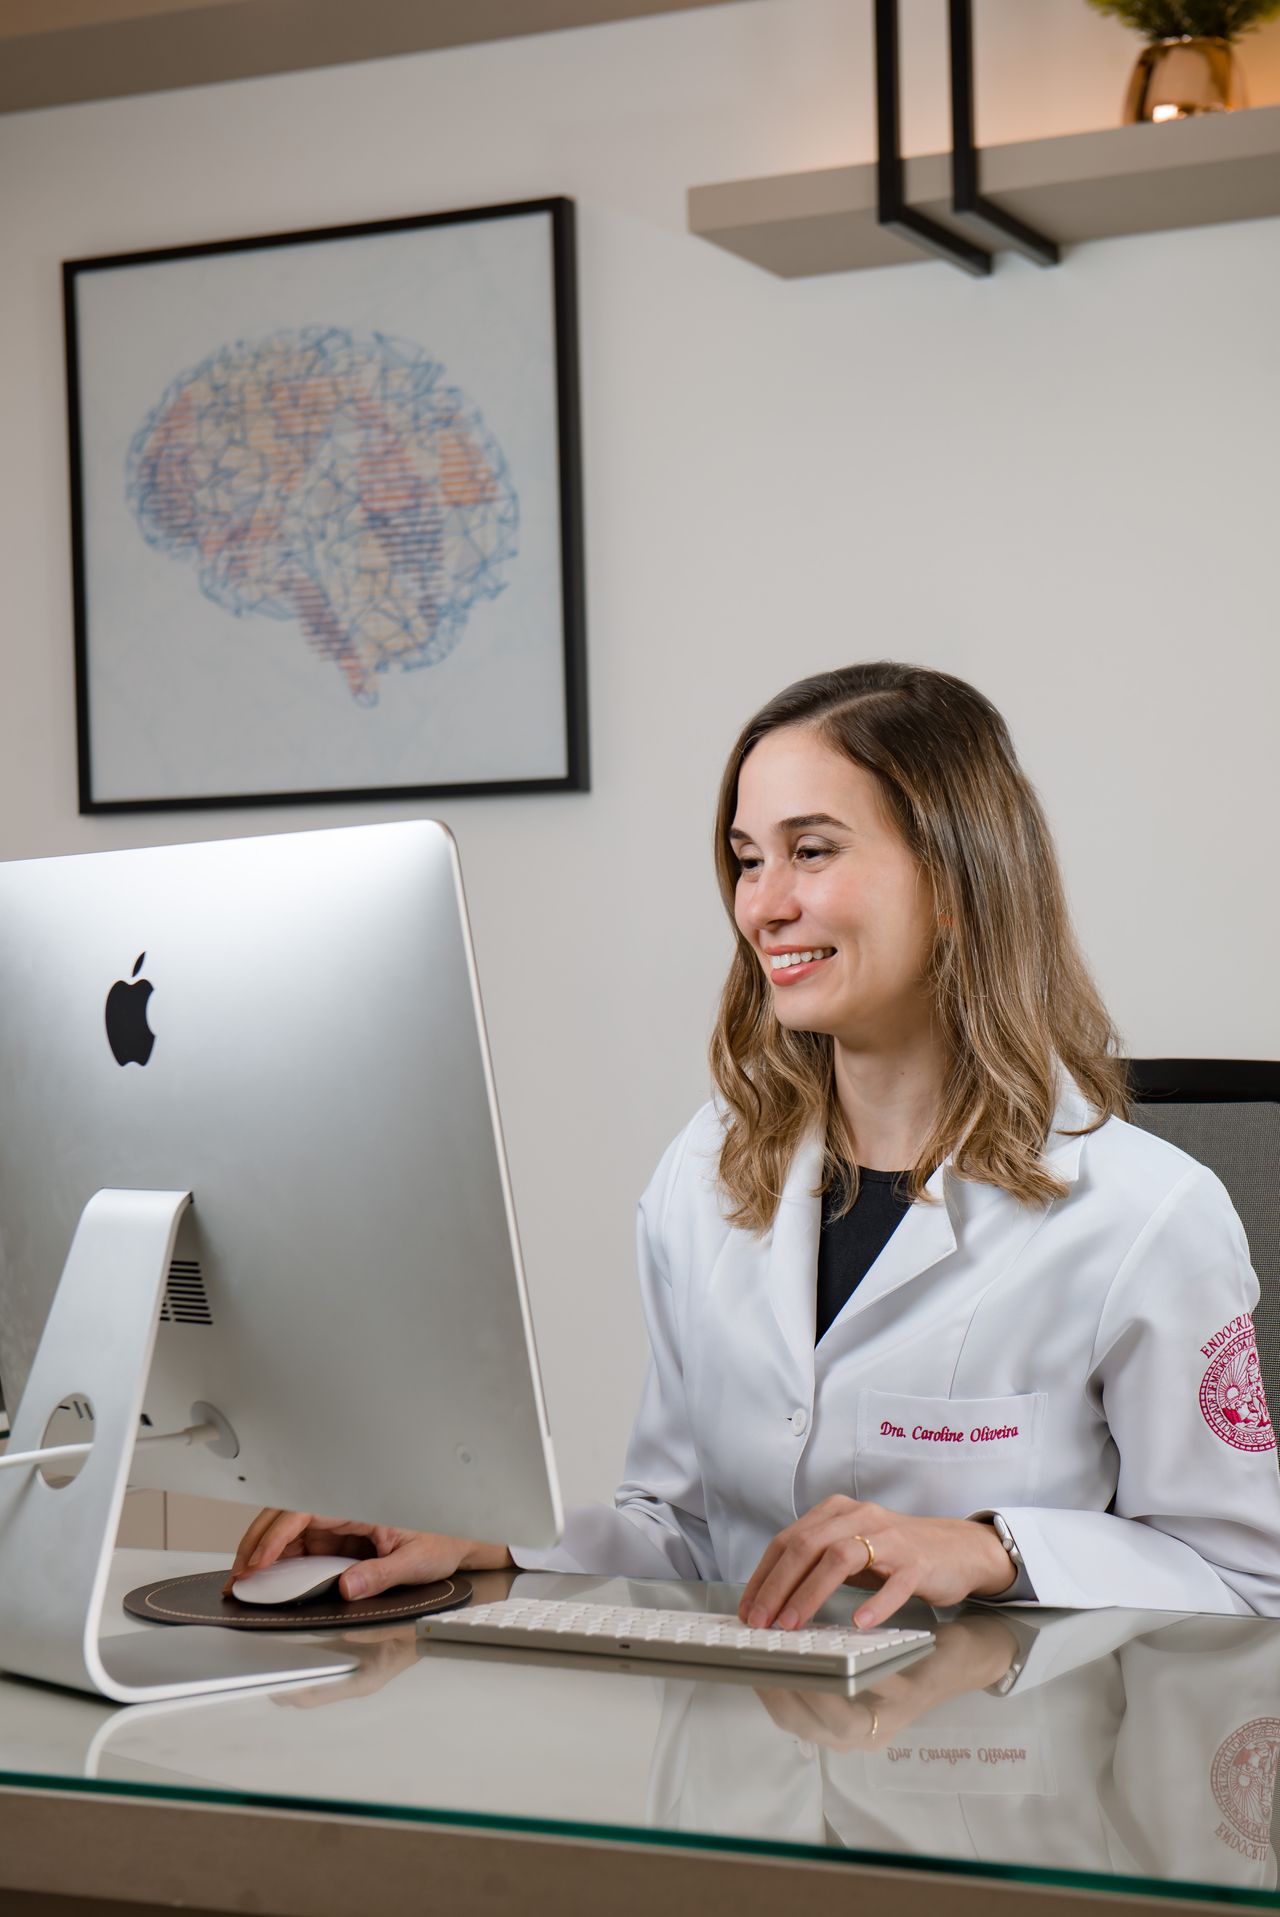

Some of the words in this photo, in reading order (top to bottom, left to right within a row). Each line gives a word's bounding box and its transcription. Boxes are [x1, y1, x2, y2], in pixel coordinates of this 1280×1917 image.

[1210, 1347, 1238, 1384] MEDICINA
[1207, 1384, 1217, 1397] DE
[880, 1421, 906, 1438] Dra.
[912, 1426, 964, 1442] Caroline
[970, 1425, 1018, 1442] Oliveira
[1208, 1398, 1237, 1439] FACULDADE
